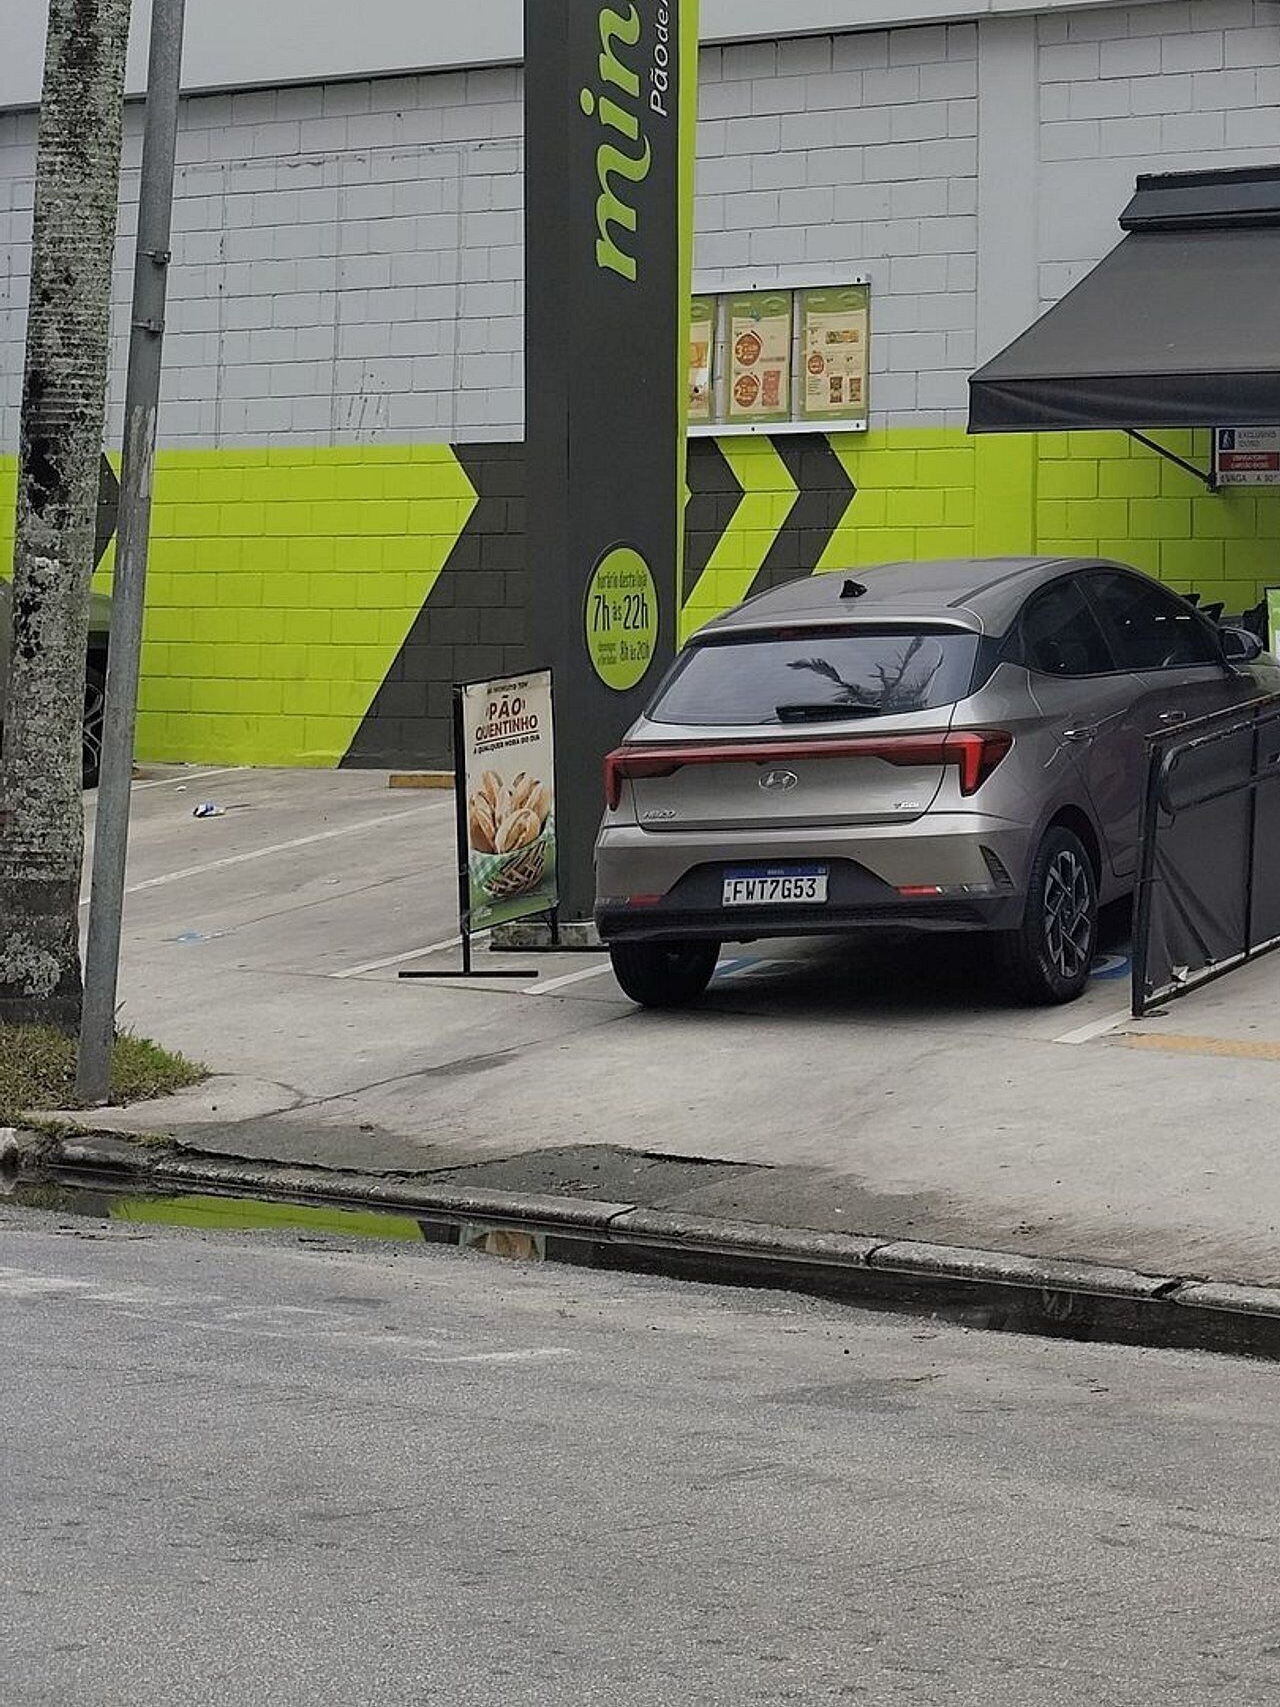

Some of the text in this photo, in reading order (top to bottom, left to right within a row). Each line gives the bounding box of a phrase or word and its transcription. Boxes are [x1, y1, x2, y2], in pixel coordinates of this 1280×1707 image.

[594, 593, 611, 632] 7h
[623, 592, 649, 630] 22h
[489, 695, 522, 720] PÃO
[475, 714, 538, 741] QUENTINHO
[733, 878, 816, 901] FWT7G53
